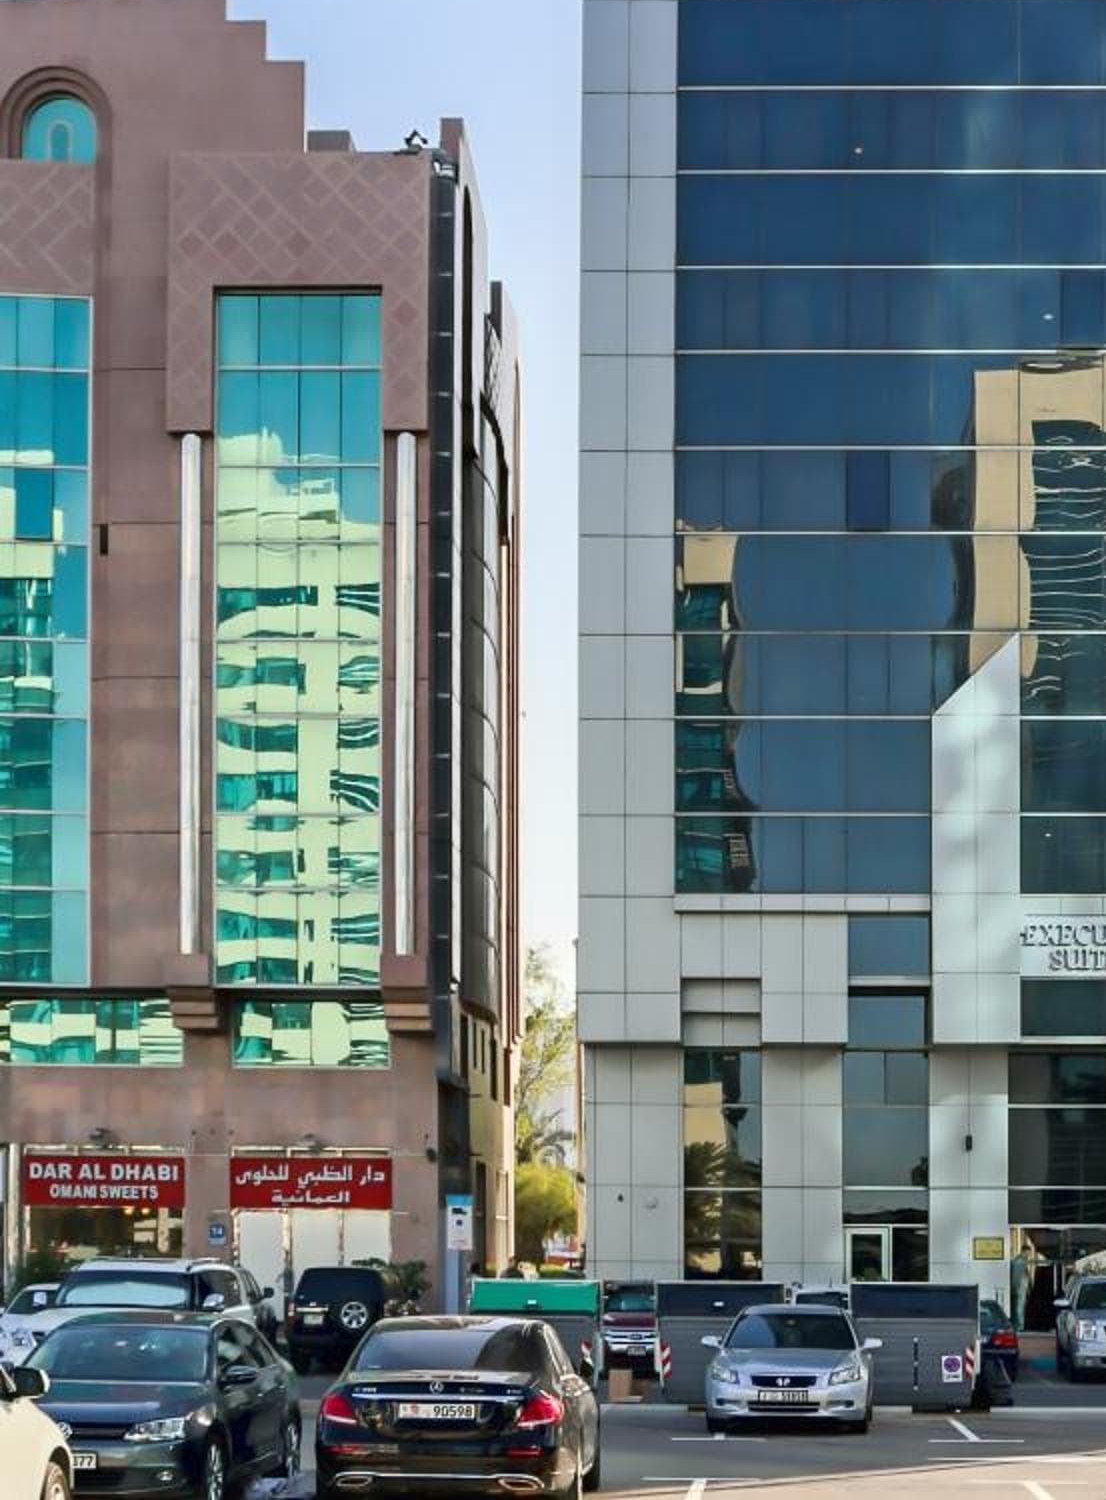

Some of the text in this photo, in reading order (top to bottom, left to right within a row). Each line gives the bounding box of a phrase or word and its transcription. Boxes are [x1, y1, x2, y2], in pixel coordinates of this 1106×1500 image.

[29, 1162, 179, 1181] DAR AL DHABI
[297, 1163, 353, 1189] الظبي
[359, 1164, 386, 1186] دار
[49, 1183, 159, 1200] OMANI SWEETS
[271, 1188, 351, 1206] العمانية
[433, 1404, 474, 1418] 90598
